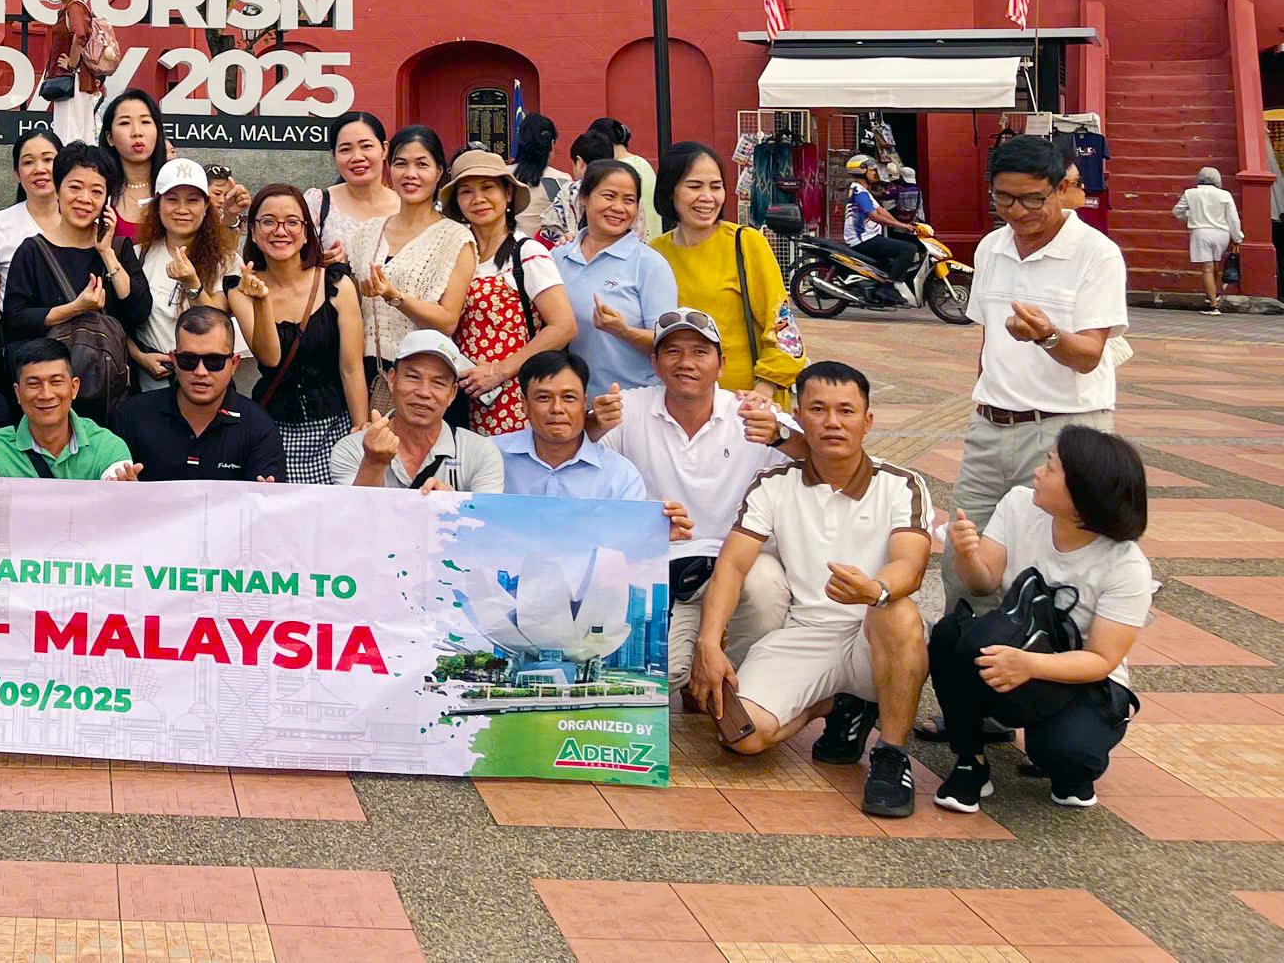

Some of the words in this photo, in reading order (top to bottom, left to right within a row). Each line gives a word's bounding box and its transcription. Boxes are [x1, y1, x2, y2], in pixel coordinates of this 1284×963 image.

[157, 49, 355, 118] 2025
[144, 565, 299, 596] VIETNAM
[309, 573, 357, 600] TO
[33, 610, 389, 675] MALAYSIA
[557, 719, 633, 734] ORGANIZED
[636, 724, 653, 736] BY
